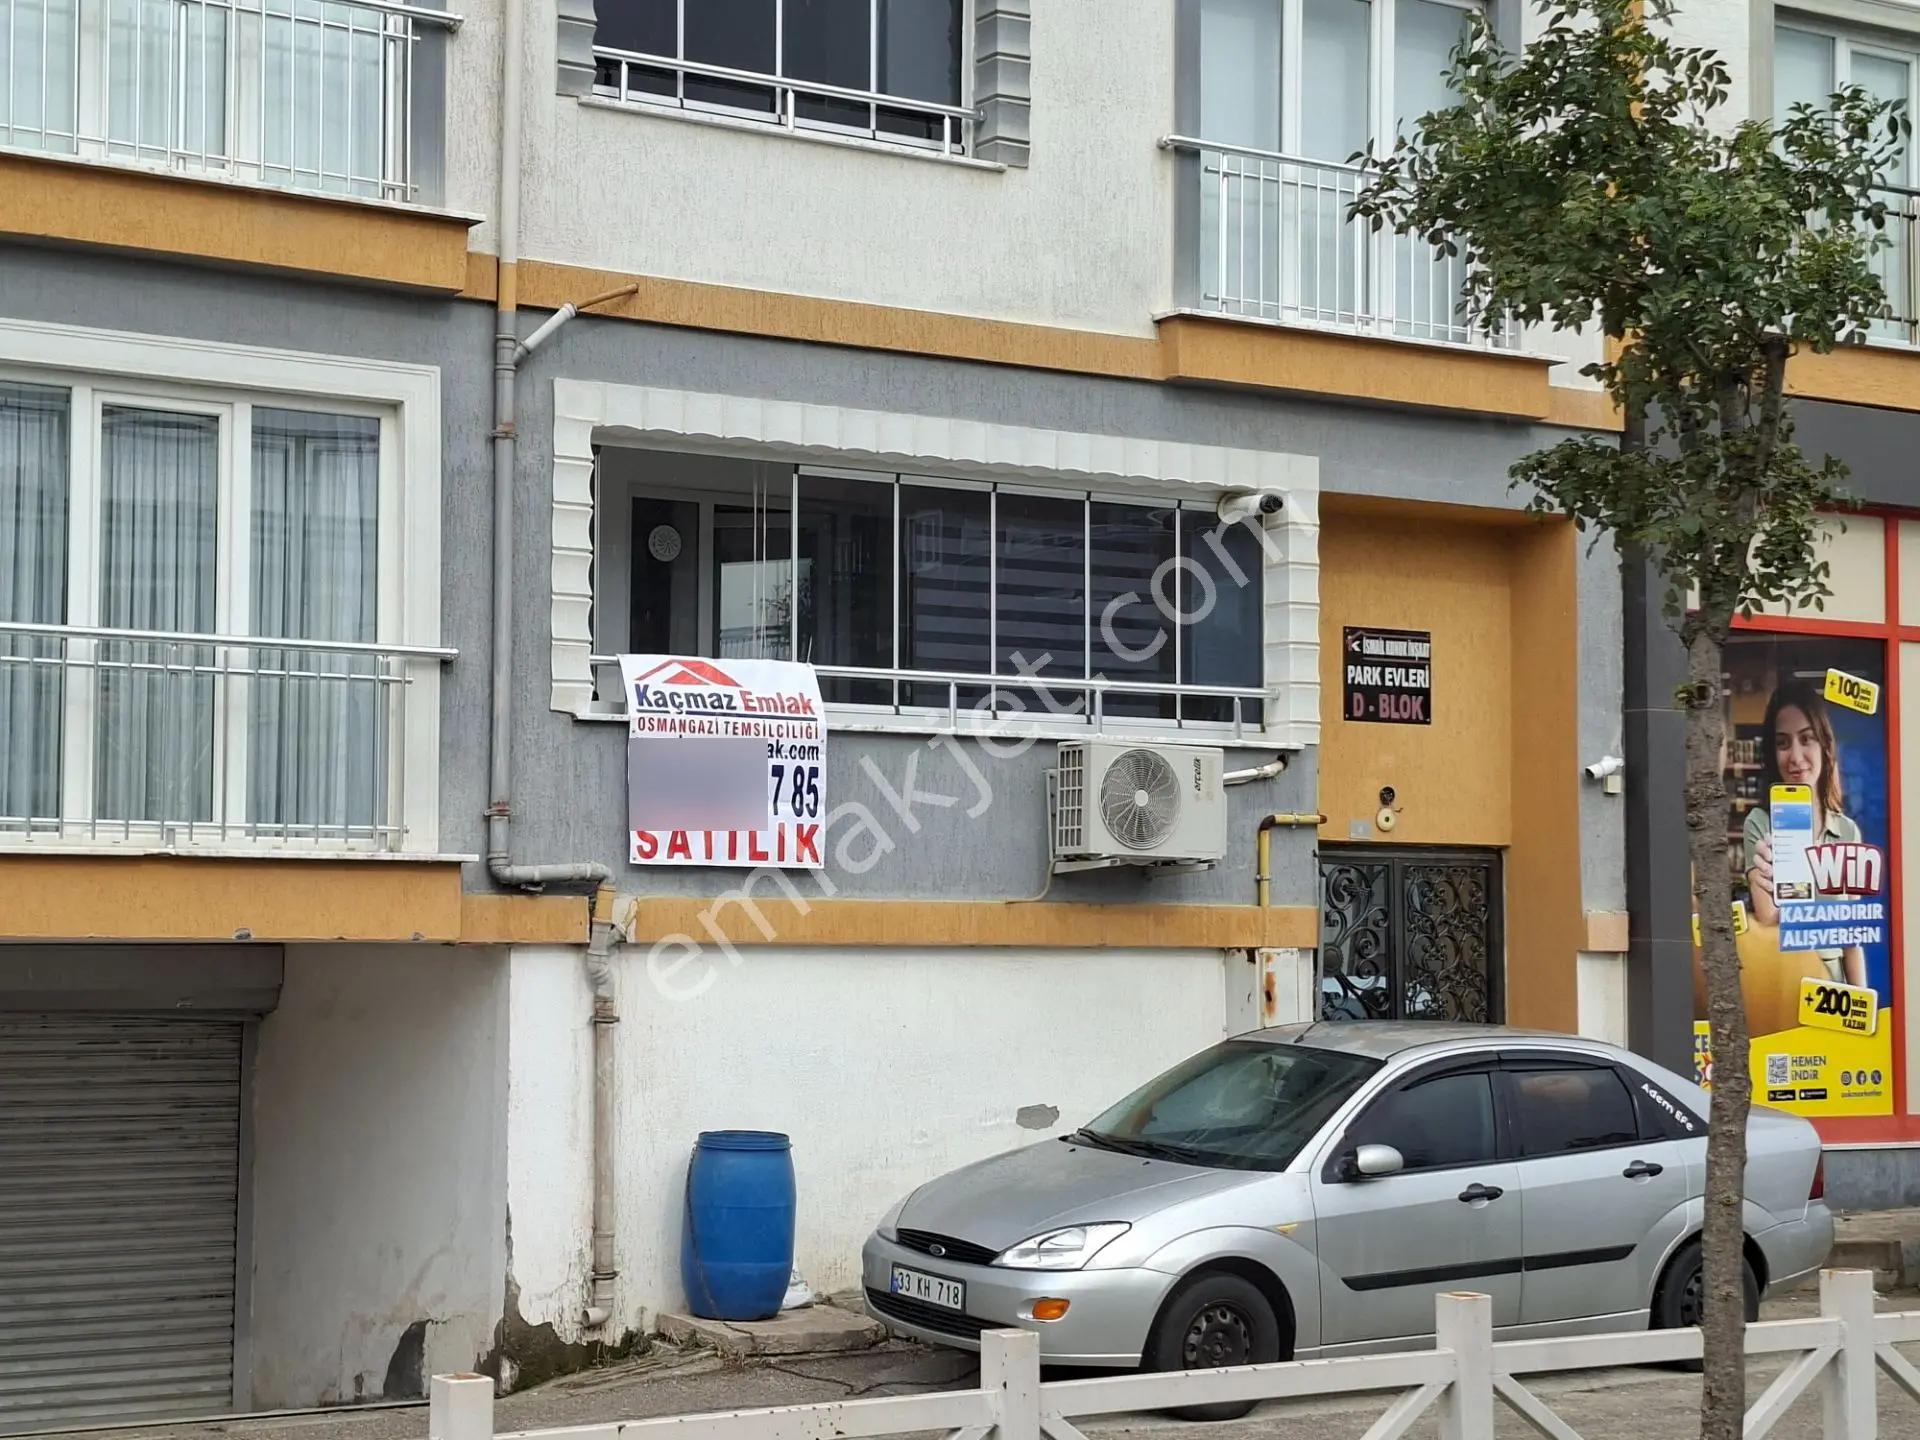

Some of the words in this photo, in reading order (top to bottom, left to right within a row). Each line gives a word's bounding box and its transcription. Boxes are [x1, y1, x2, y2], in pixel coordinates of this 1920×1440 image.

[1347, 665, 1381, 686] PARK
[1385, 665, 1429, 688] EVLERİ
[635, 684, 737, 714] Kaçmaz
[739, 690, 815, 715] Emlak
[1353, 692, 1364, 717] D
[1379, 693, 1424, 720] BLOK
[637, 716, 719, 734] OSMANGAZİ
[791, 766, 819, 817] 85
[1806, 844, 1882, 894] Win
[1780, 903, 1883, 923] KAZANDIRIR
[1791, 1056, 1826, 1066] HEMEN
[1641, 1083, 1674, 1115] Adem
[898, 1272, 911, 1292] 33
[917, 1276, 931, 1297] KH
[938, 1282, 959, 1305] 718
